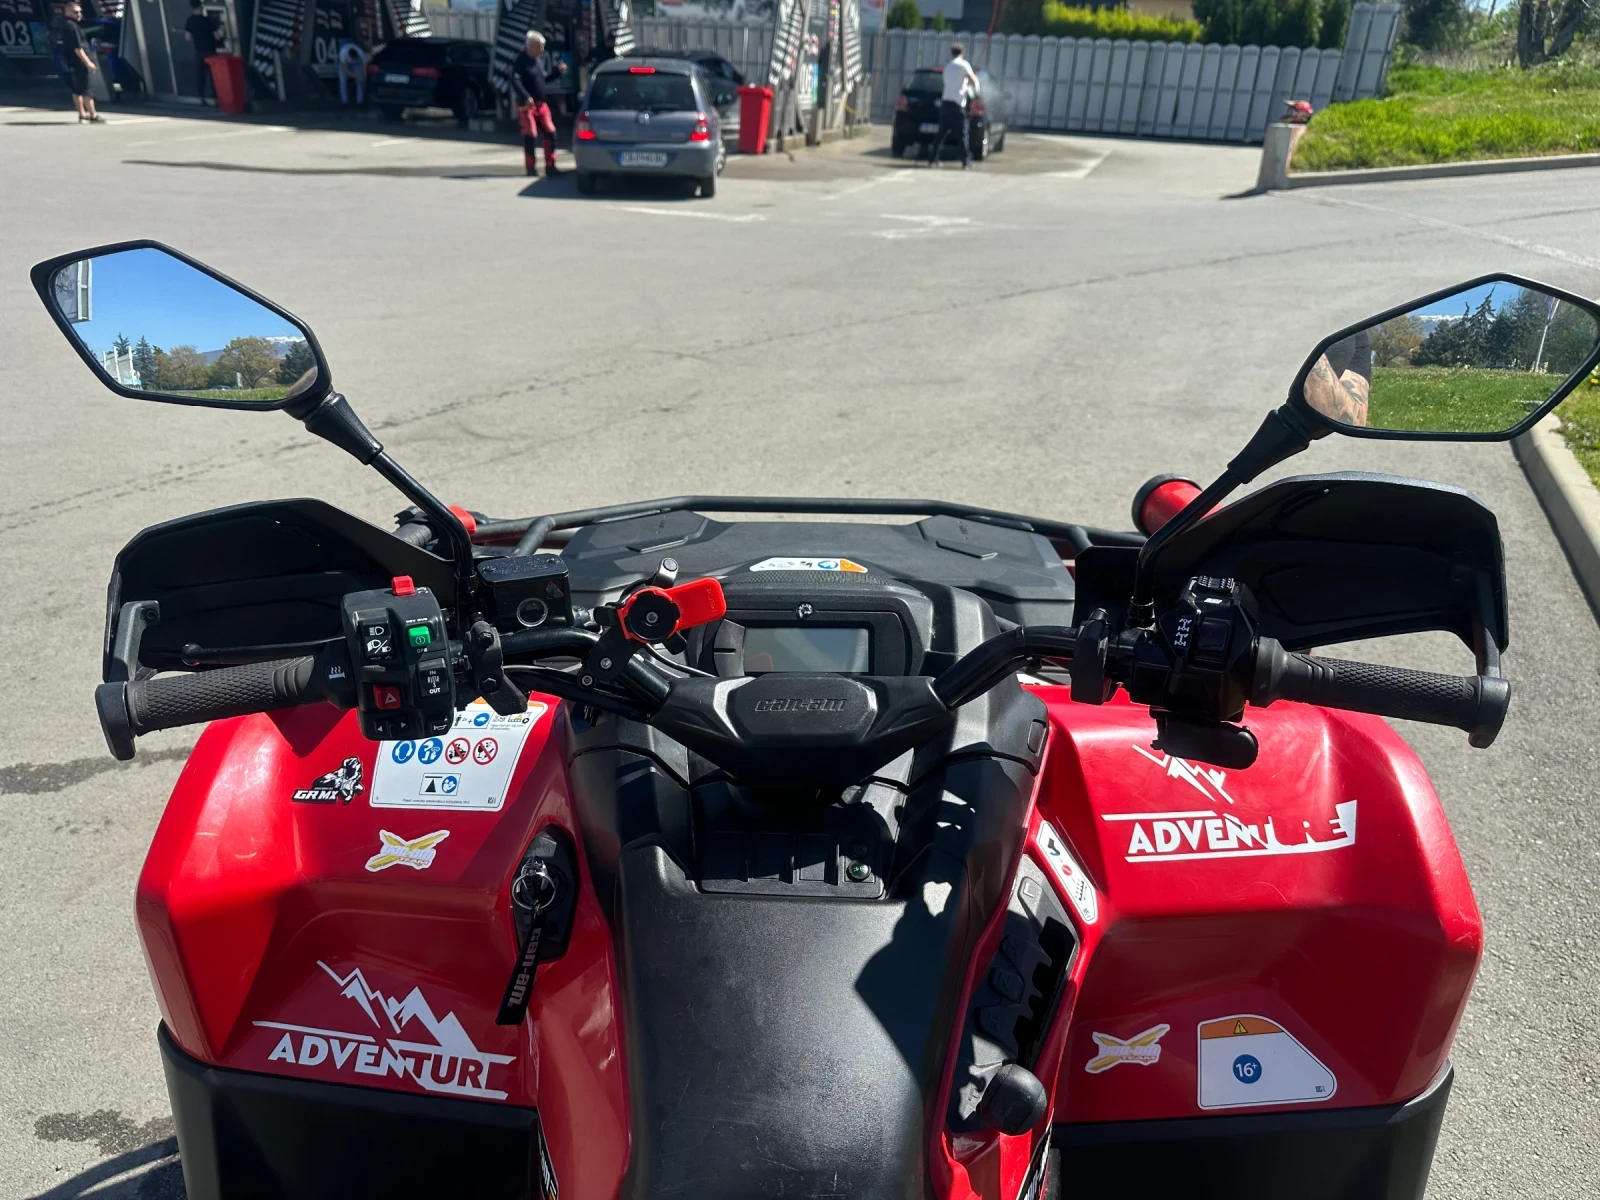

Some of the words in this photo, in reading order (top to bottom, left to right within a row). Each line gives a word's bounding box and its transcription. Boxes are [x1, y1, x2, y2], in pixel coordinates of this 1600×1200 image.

[1, 20, 31, 46] 03
[315, 37, 338, 64] 04
[754, 697, 849, 713] can-am
[509, 927, 542, 1006] can-am
